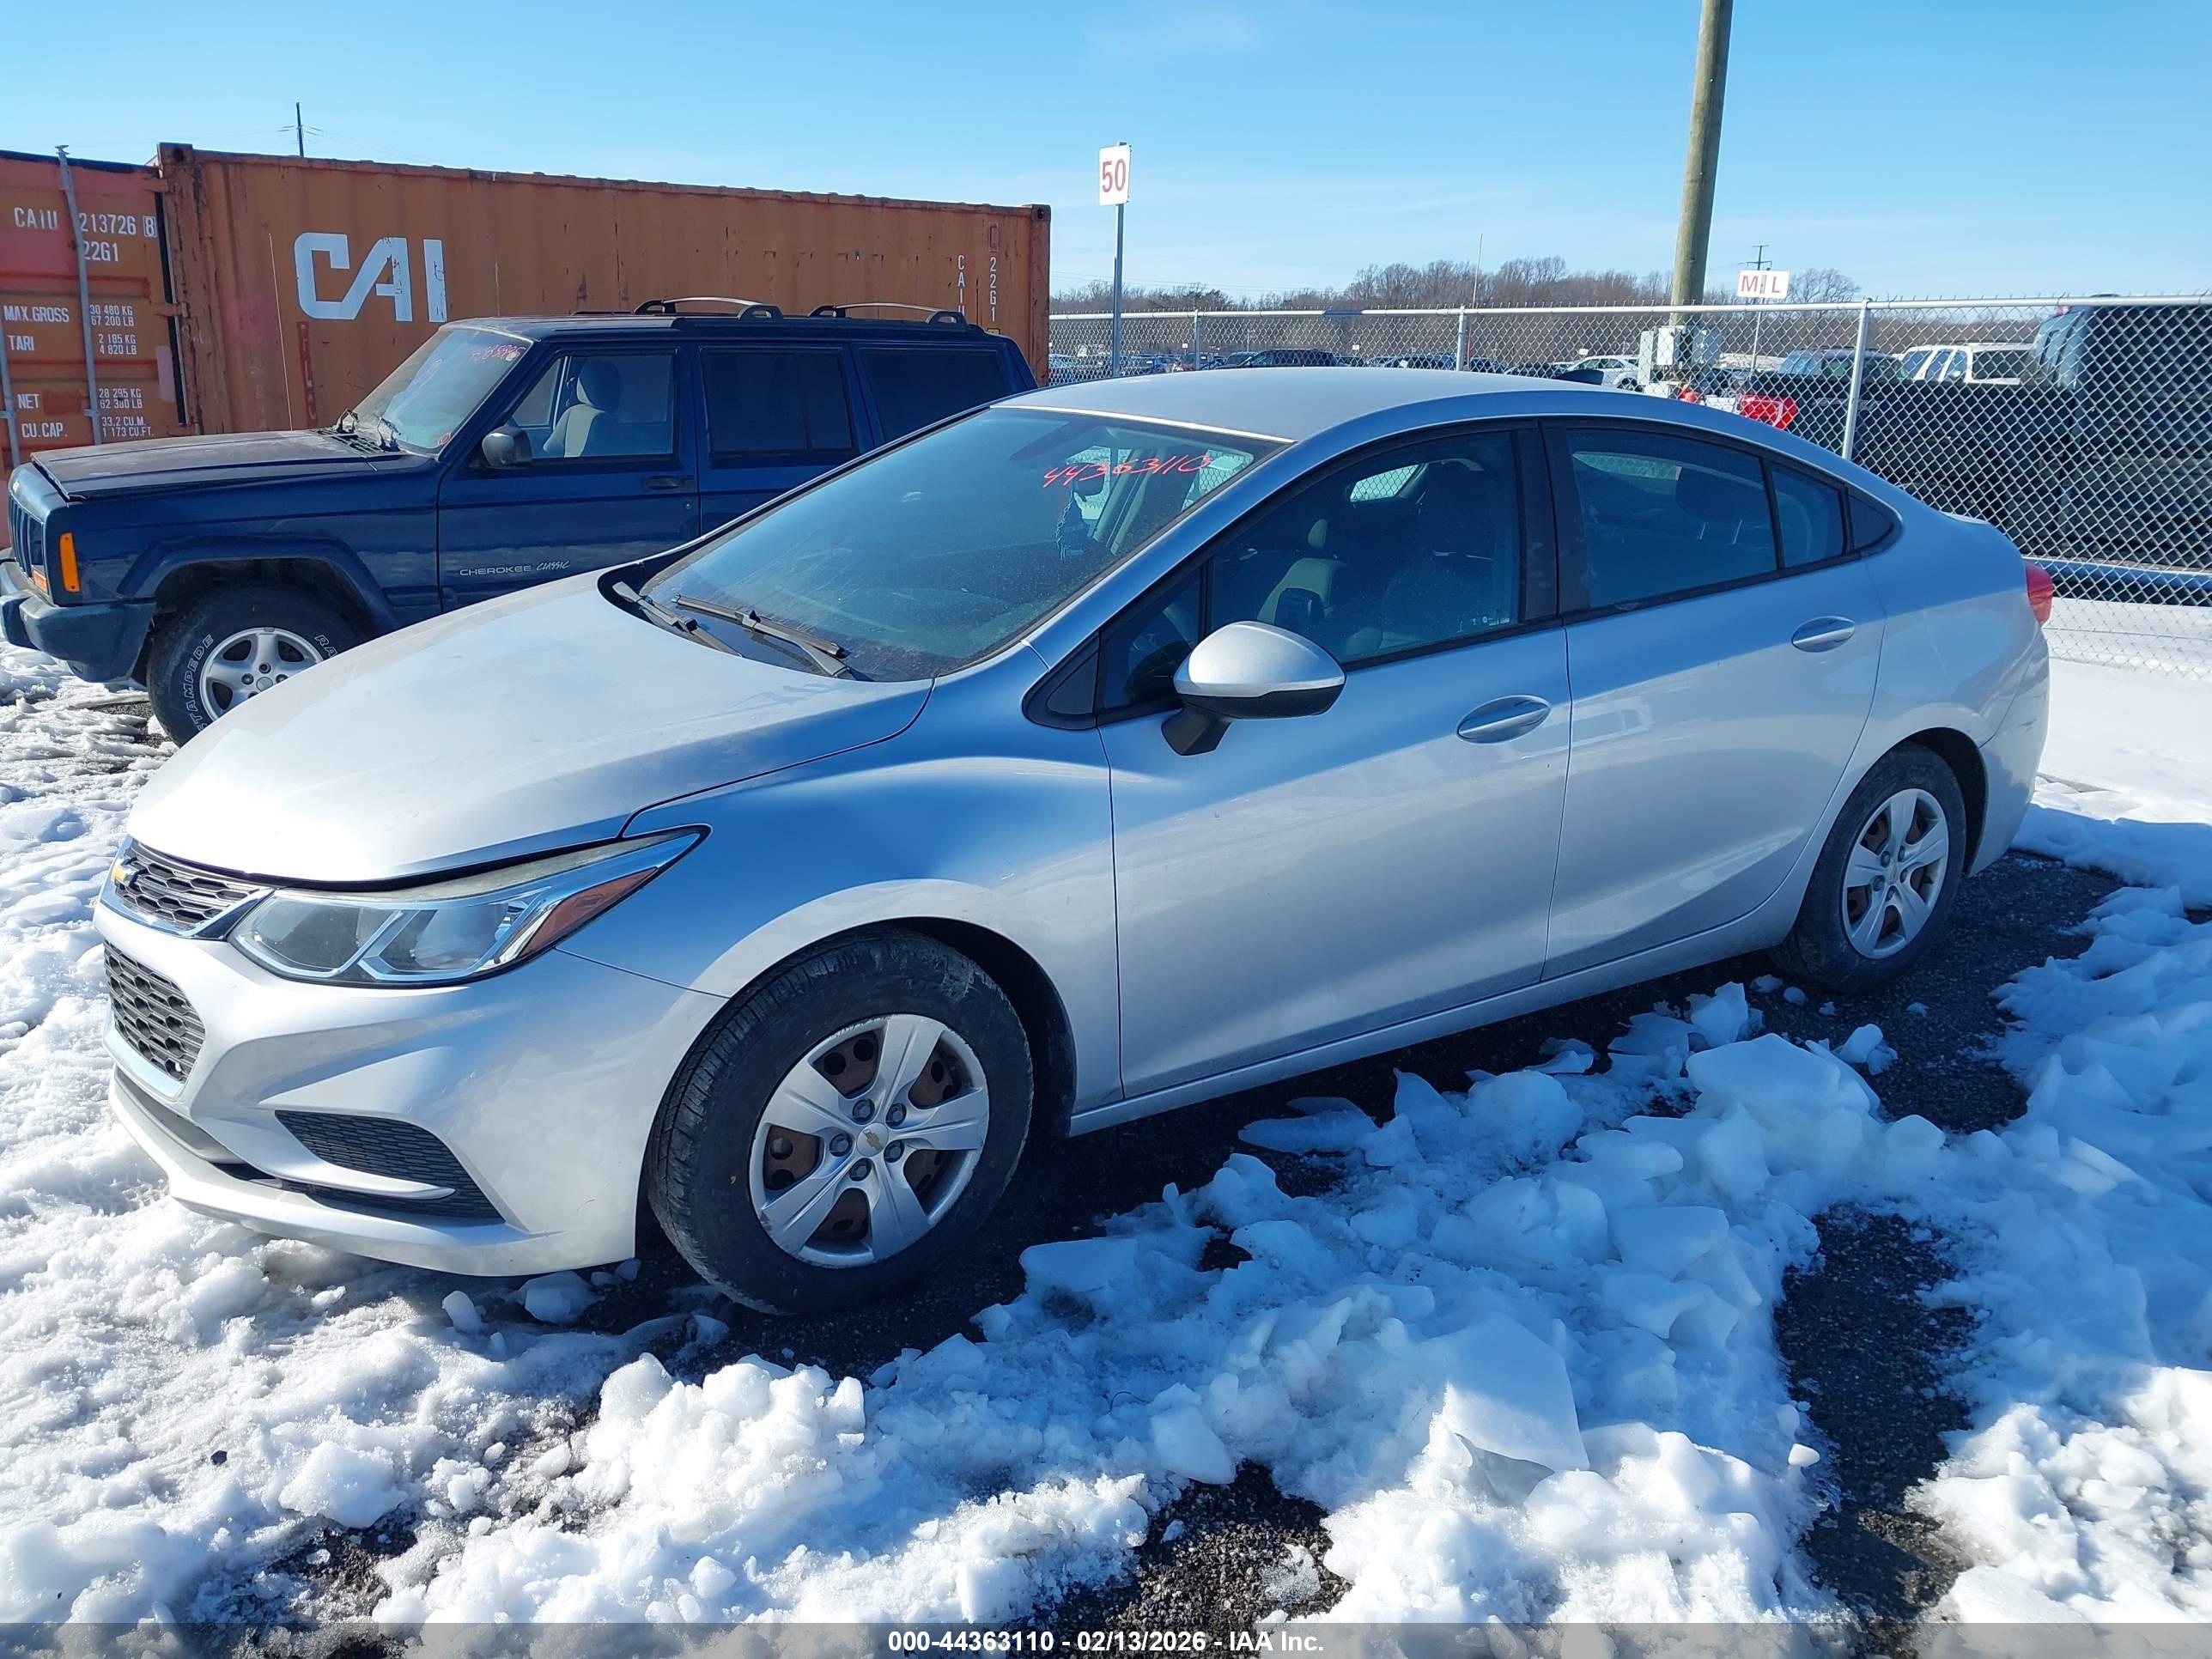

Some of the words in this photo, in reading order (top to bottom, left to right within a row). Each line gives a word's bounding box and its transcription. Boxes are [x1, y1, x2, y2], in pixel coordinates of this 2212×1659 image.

[1102, 158, 1127, 193] 50
[14, 207, 58, 230] CAIU
[79, 212, 137, 235] 213726
[144, 217, 155, 236] 8
[83, 240, 119, 262] 22G1
[295, 232, 447, 323] CAI
[3, 305, 70, 323] MAX.GROSS
[89, 304, 101, 315] 30
[104, 305, 119, 315] 480
[121, 306, 133, 316] KG
[90, 315, 101, 325] 67
[105, 316, 121, 326] 200
[123, 316, 134, 326] LB
[98, 333, 104, 343] 2
[107, 333, 123, 344] 185
[125, 334, 136, 344] KG
[100, 344, 105, 355] 4
[125, 344, 137, 355] LB
[99, 388, 110, 398] 28
[112, 388, 129, 398] 295
[130, 388, 142, 398] KG
[17, 393, 40, 409] NET
[100, 398, 111, 409] 62
[131, 398, 143, 409] LB
[101, 416, 121, 427] 33.2
[21, 422, 69, 438] CU.CAP.
[112, 427, 126, 437] 173
[1042, 453, 1212, 489] 44363110
[459, 565, 532, 576] CHEROKEE
